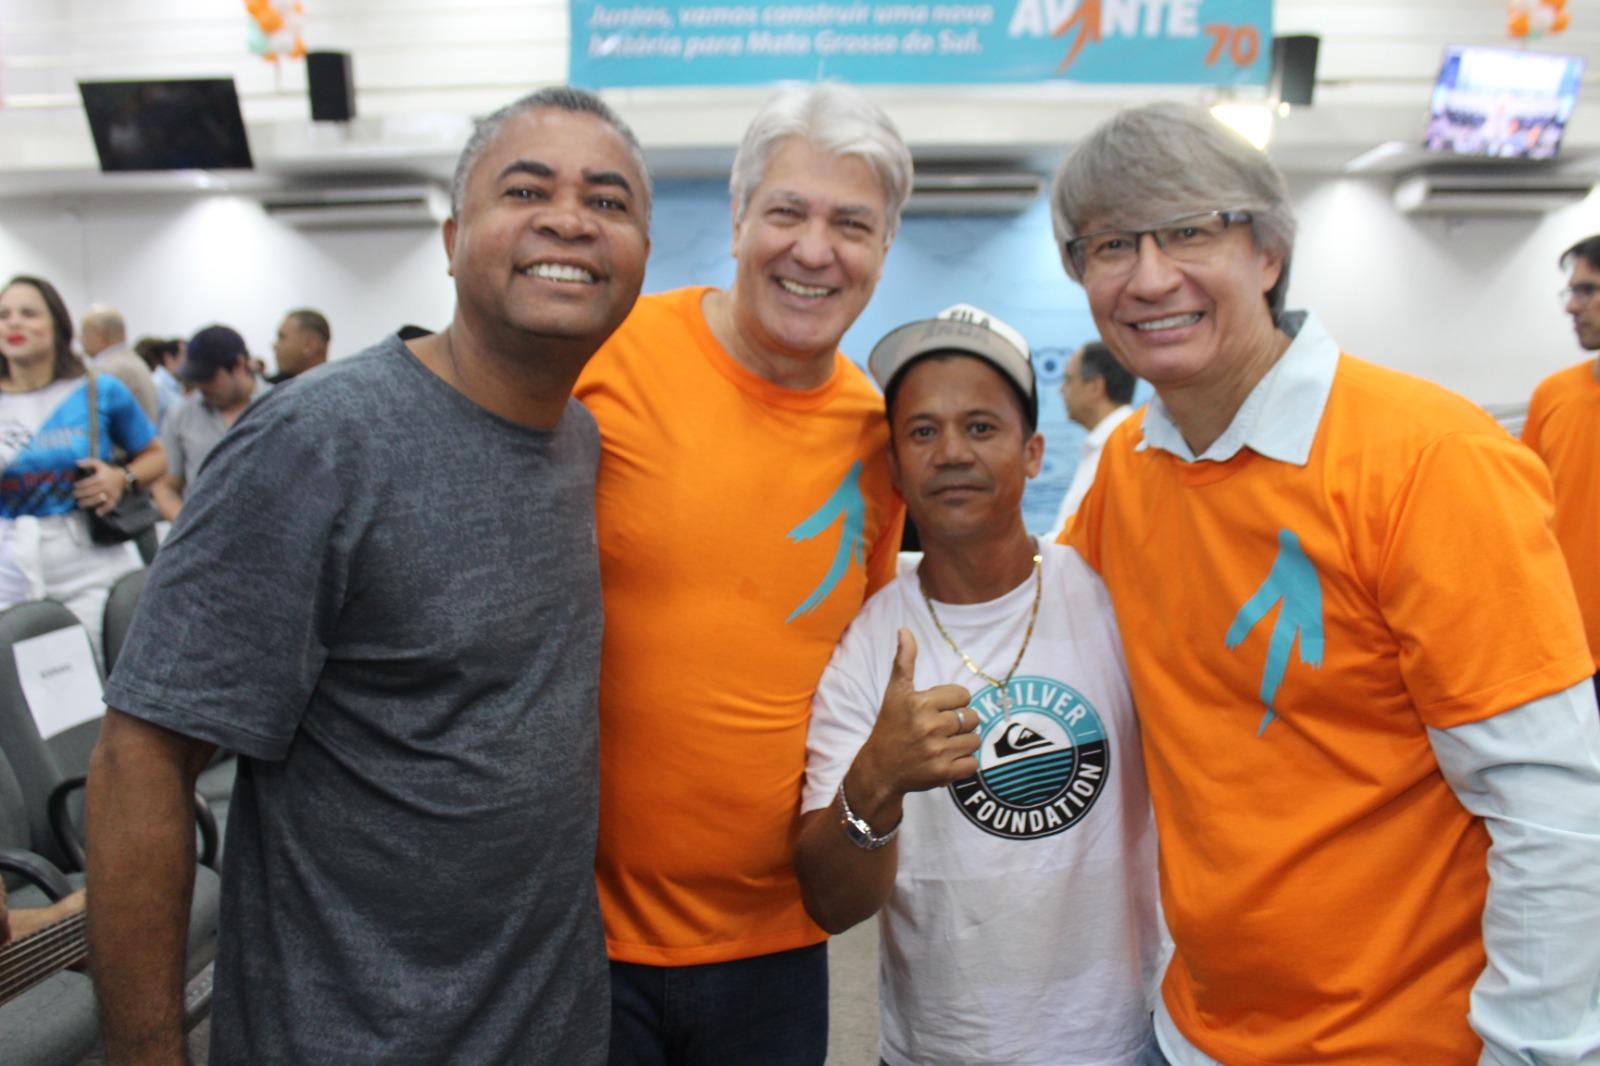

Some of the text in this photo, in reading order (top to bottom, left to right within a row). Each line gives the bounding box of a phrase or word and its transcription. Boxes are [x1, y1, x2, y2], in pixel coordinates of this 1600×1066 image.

[680, 7, 757, 25] vamos
[761, 5, 871, 25] construir
[875, 5, 930, 25] uma
[933, 4, 993, 25] nova
[684, 35, 745, 61] para
[748, 30, 811, 55] Mato
[814, 29, 899, 54] Grosso
[901, 28, 934, 54] do
[1204, 23, 1261, 68] 70
[963, 762, 1104, 833] FOUNDATION
